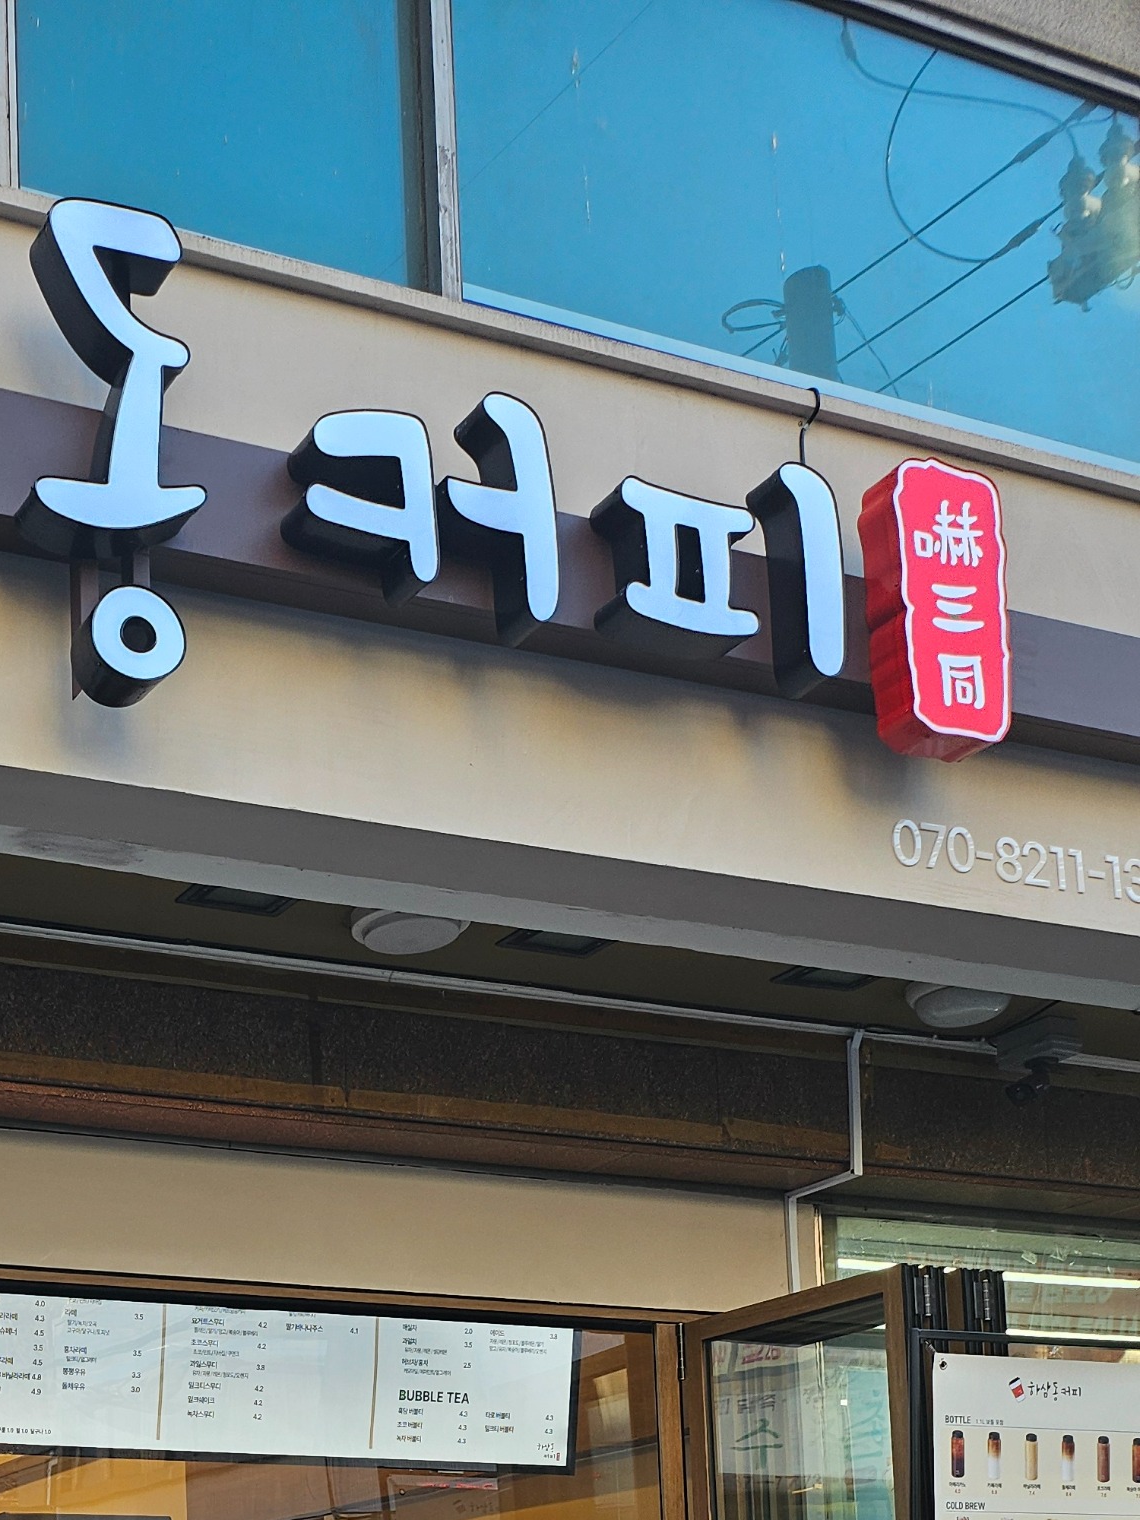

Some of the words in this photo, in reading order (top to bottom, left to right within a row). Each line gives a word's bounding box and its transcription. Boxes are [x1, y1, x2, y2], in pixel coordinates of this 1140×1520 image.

[133, 1313, 144, 1321] 3.5
[257, 1321, 268, 1329] 4.2
[33, 1329, 45, 1337] 4.5
[33, 1344, 44, 1352] 3.5
[256, 1342, 267, 1350] 4.2
[132, 1349, 143, 1357] 3.5
[398, 1389, 444, 1403] BUBBLE
[447, 1391, 470, 1404] TEA
[253, 1399, 263, 1407] 4.2
[252, 1413, 263, 1421] 4.2
[944, 1415, 971, 1424] BOTTLE
[945, 1501, 964, 1510] COLD
[964, 1502, 986, 1511] BREW
